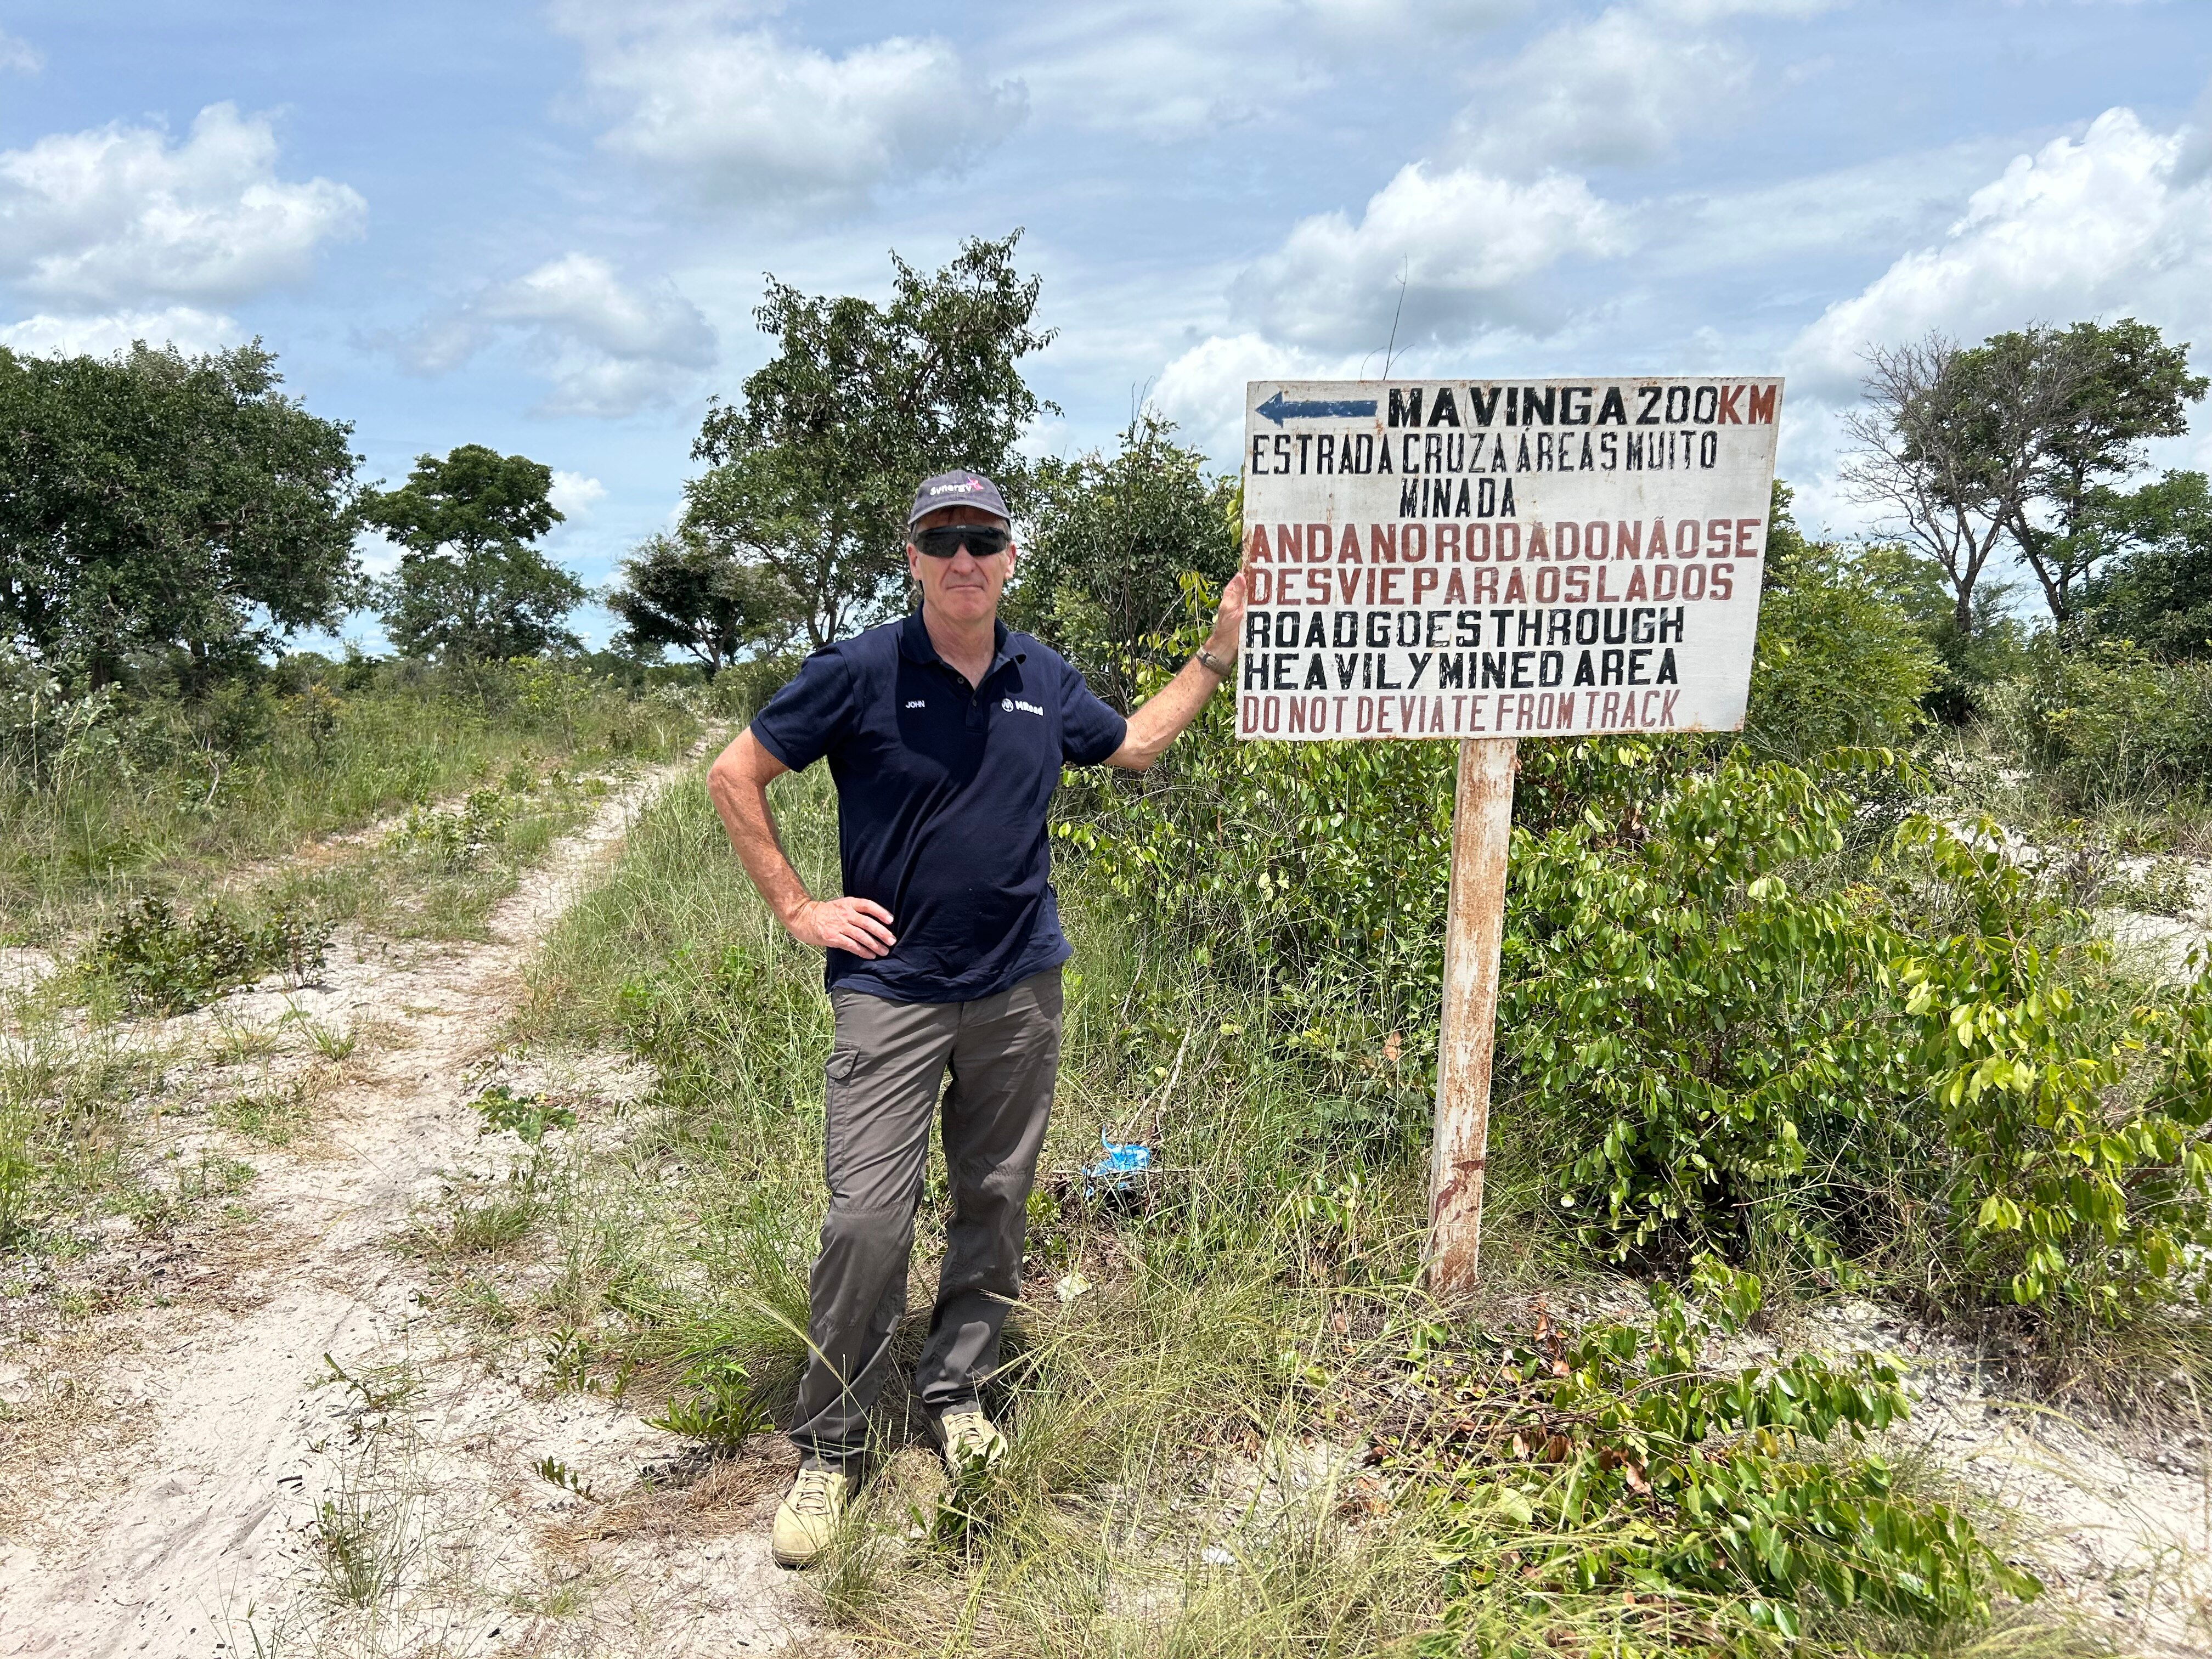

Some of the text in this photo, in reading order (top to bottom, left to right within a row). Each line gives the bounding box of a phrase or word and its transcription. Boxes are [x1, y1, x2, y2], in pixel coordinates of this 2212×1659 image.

[1388, 386, 1627, 427] MAVINGA
[1252, 434, 1393, 475] ESTRADA
[1402, 432, 1508, 474] CRUZA
[1626, 430, 1718, 471] MUITO
[1399, 477, 1516, 518] MINADA
[1250, 523, 1363, 564] ANDA
[1370, 523, 1427, 563] NO
[1616, 516, 1701, 561] NÃO
[1706, 518, 1761, 558] SE
[1247, 563, 1735, 606] DESVIE PARA OS LADOS
[1246, 606, 1685, 648] ROAD GOES THROUGH
[1244, 648, 1679, 690] HEAVILY MINED AREA
[905, 700, 925, 708] JOHN
[1243, 689, 1681, 733] DO NOT DEVIATE FROM TRACK
